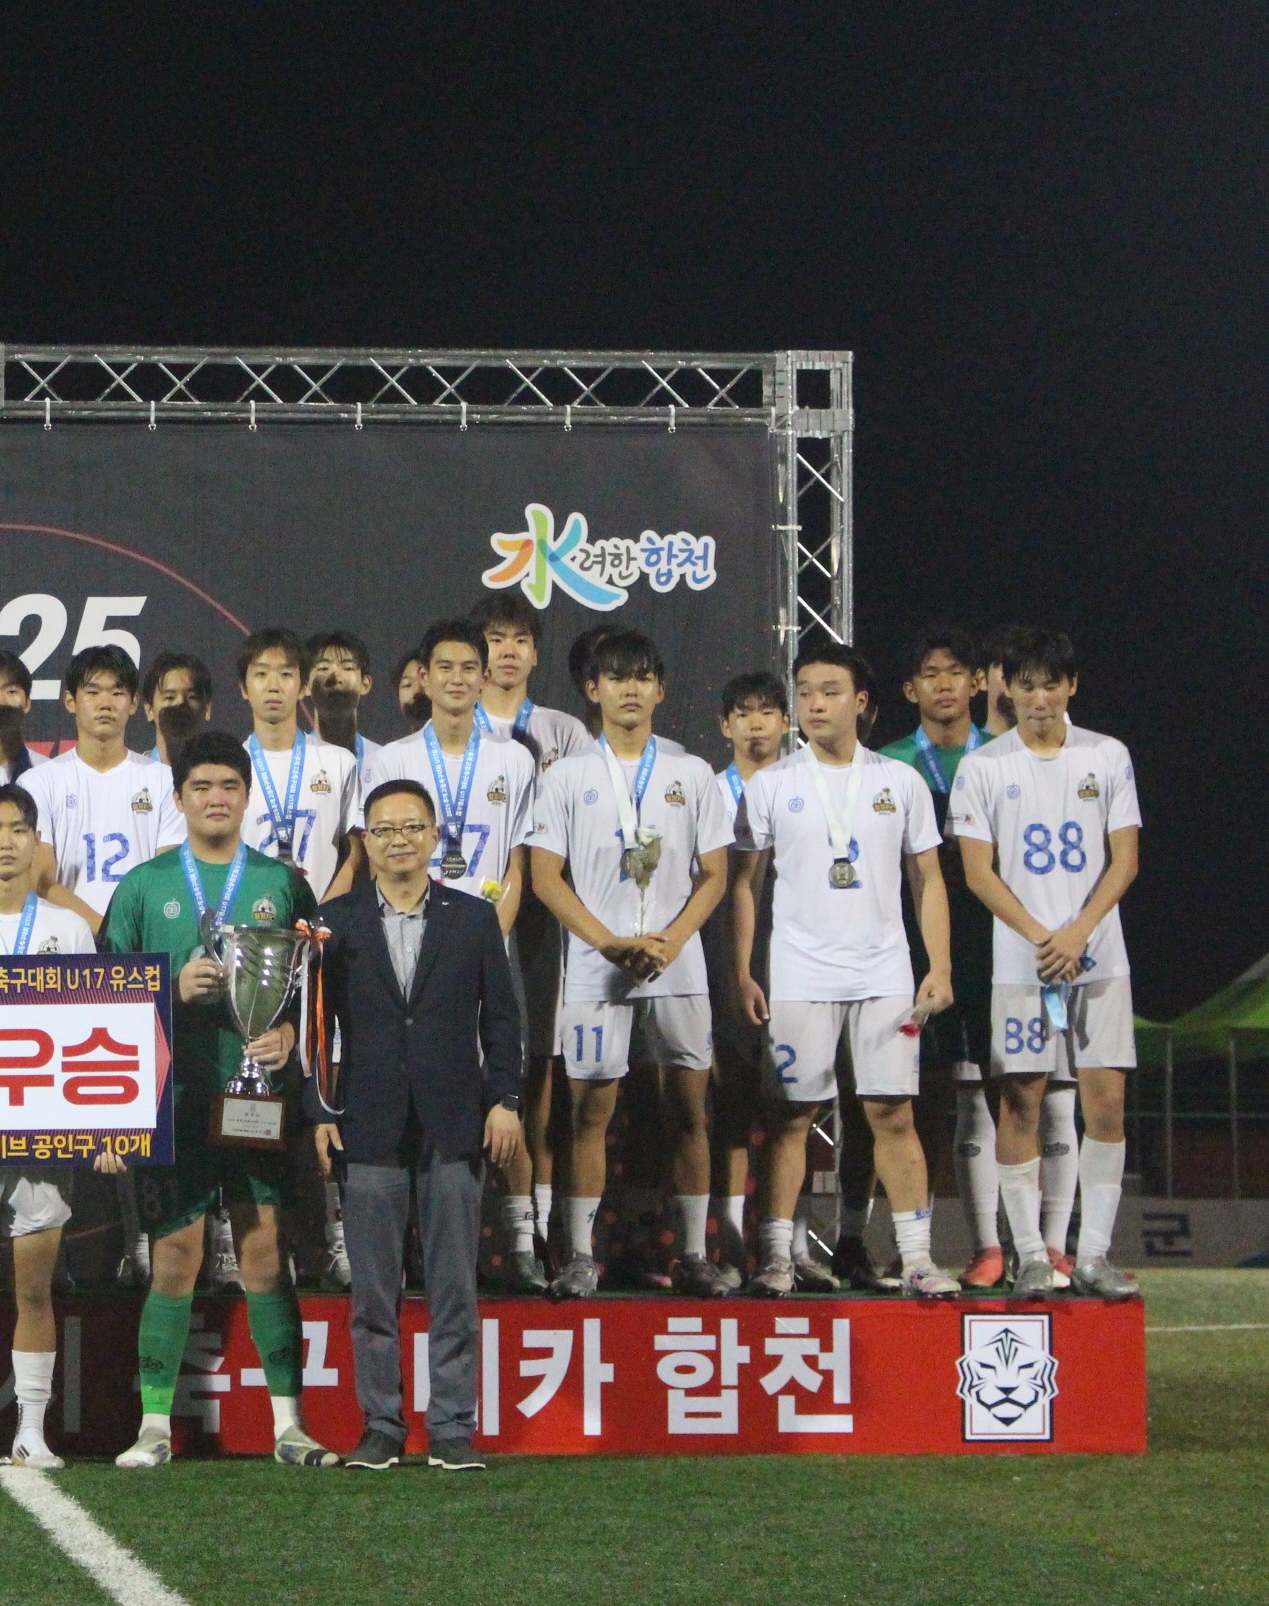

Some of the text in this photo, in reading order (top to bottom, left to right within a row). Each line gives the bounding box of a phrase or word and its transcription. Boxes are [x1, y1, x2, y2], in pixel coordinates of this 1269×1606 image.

[640, 535, 710, 586] 합천
[82, 832, 130, 883] 12
[1023, 820, 1087, 876] 88
[66, 967, 105, 991] U17
[109, 965, 161, 992] 유스컵
[573, 1024, 603, 1064] 11
[1005, 1017, 1045, 1055] 88
[775, 1043, 799, 1084] 2
[32, 1134, 96, 1159] 공인구
[102, 1133, 152, 1158] 10개
[654, 1317, 853, 1435] 합천
